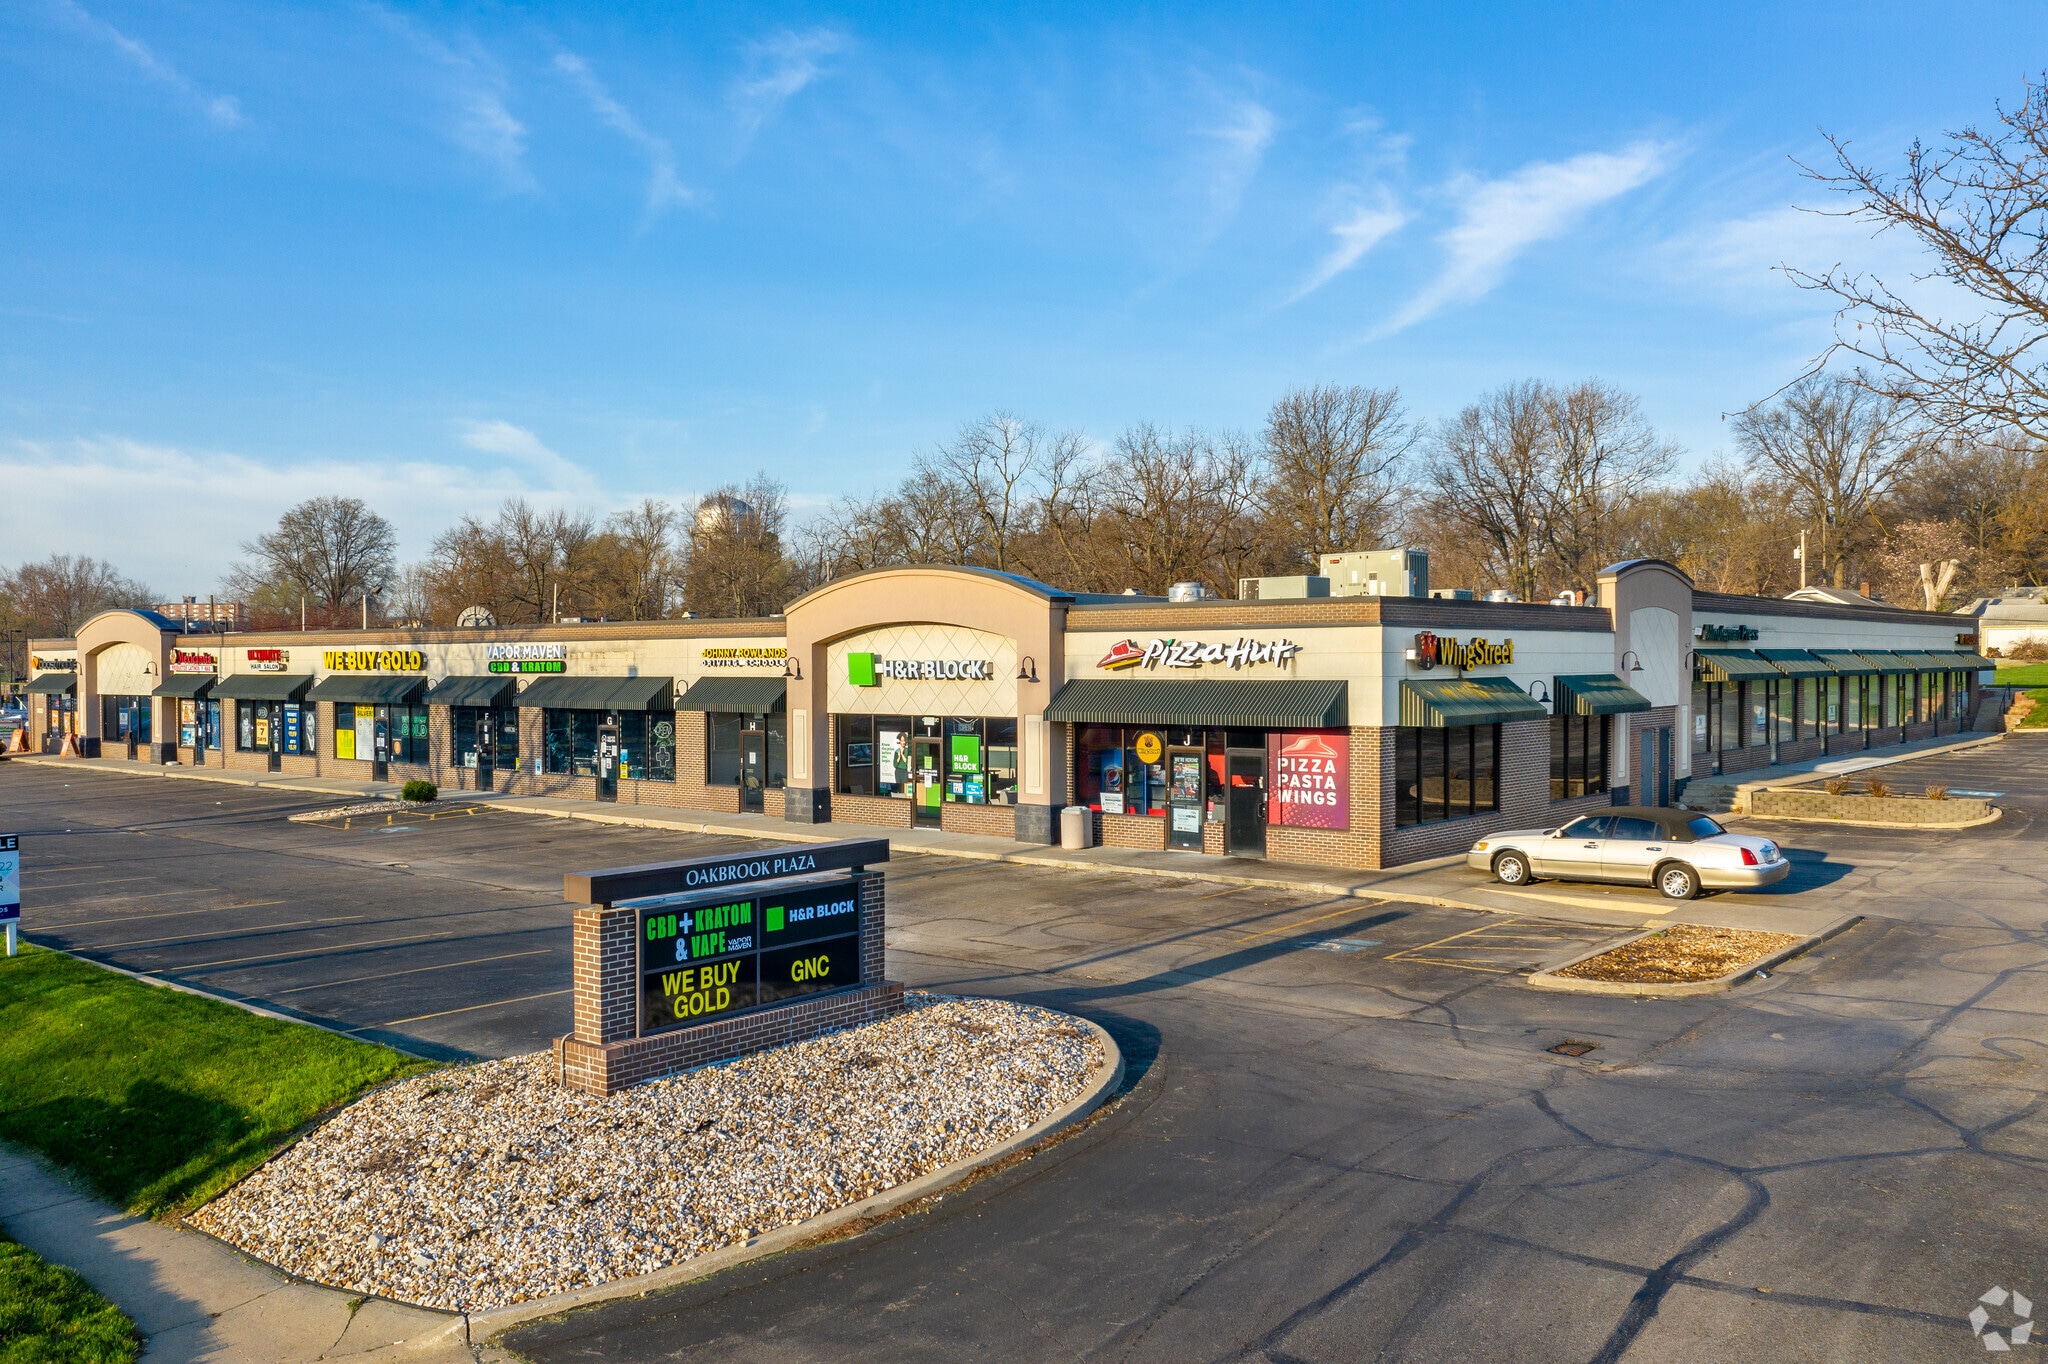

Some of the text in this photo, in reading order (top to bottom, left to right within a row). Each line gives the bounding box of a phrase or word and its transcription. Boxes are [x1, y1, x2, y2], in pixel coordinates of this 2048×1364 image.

[247, 649, 281, 661] ULTIMATE
[486, 645, 561, 659] VAPOR MAVEN
[701, 648, 787, 658] JOHNNY ROWLANDS
[1142, 638, 1294, 668] Pizza Hut
[1440, 637, 1514, 671] WingStreet
[323, 651, 422, 670] WE BUY GOLD
[489, 661, 562, 673] CBD & KRATOM
[702, 659, 787, 667] DRIVING SCHOOLS
[883, 660, 986, 679] H&R BLOCK
[380, 709, 384, 717] E
[484, 712, 489, 720] F
[606, 716, 613, 725] G
[750, 722, 755, 731] H
[260, 727, 265, 736] 7
[1183, 734, 1190, 746] J
[954, 754, 969, 763] H&R
[1277, 757, 1336, 774] PIZZA
[954, 762, 977, 771] BLOCK
[1277, 774, 1336, 790] PASTA
[1277, 790, 1337, 806] WINGS
[685, 854, 816, 886] OAKBROOK PLAZA
[789, 899, 855, 923] H&R BLOCK
[646, 914, 677, 941] CBD
[695, 902, 752, 932] KRATOM
[675, 931, 726, 962] & VAPE
[728, 936, 751, 945] VAPOR
[728, 942, 752, 951] MAVEN
[791, 955, 830, 982] GNC
[662, 960, 741, 997] WE BUY
[673, 986, 730, 1019] GOLD
